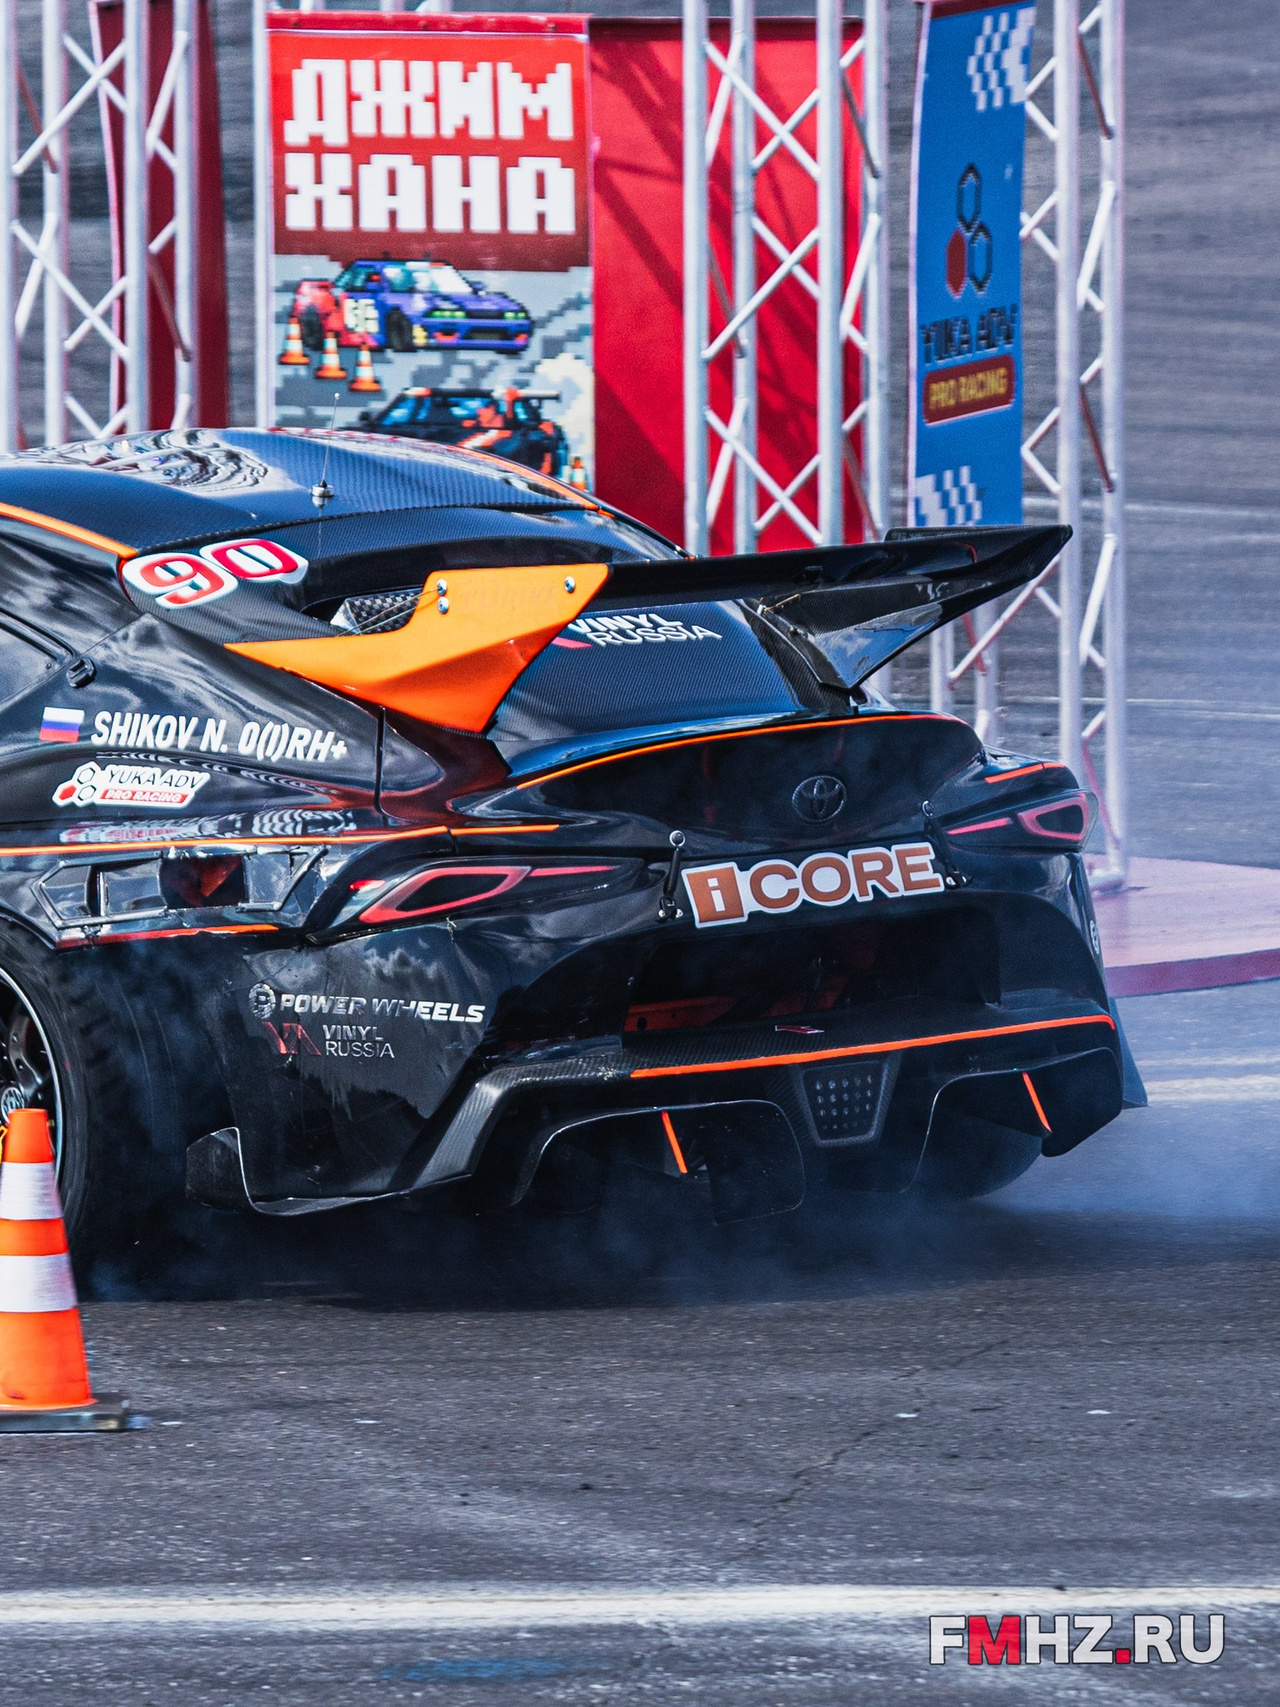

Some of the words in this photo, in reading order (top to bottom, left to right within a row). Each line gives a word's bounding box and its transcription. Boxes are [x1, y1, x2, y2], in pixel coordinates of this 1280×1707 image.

[284, 58, 574, 146] ДЖИМ
[284, 153, 576, 234] ХАНА
[928, 379, 956, 410] PRO
[958, 367, 1008, 403] RACING
[126, 539, 309, 608] 90
[568, 613, 684, 635] VINYL
[586, 625, 723, 647] RUSSIA
[91, 711, 198, 750] SHIKOV
[200, 718, 228, 753] N.
[108, 769, 157, 786] YUKA
[160, 772, 204, 789] ADV
[104, 789, 132, 801] PRO
[133, 791, 183, 803] RACING
[280, 993, 367, 1015] POWER
[372, 997, 486, 1023] WHEELS
[323, 1024, 384, 1042] VINYL
[325, 1041, 395, 1058] RUSSIA
